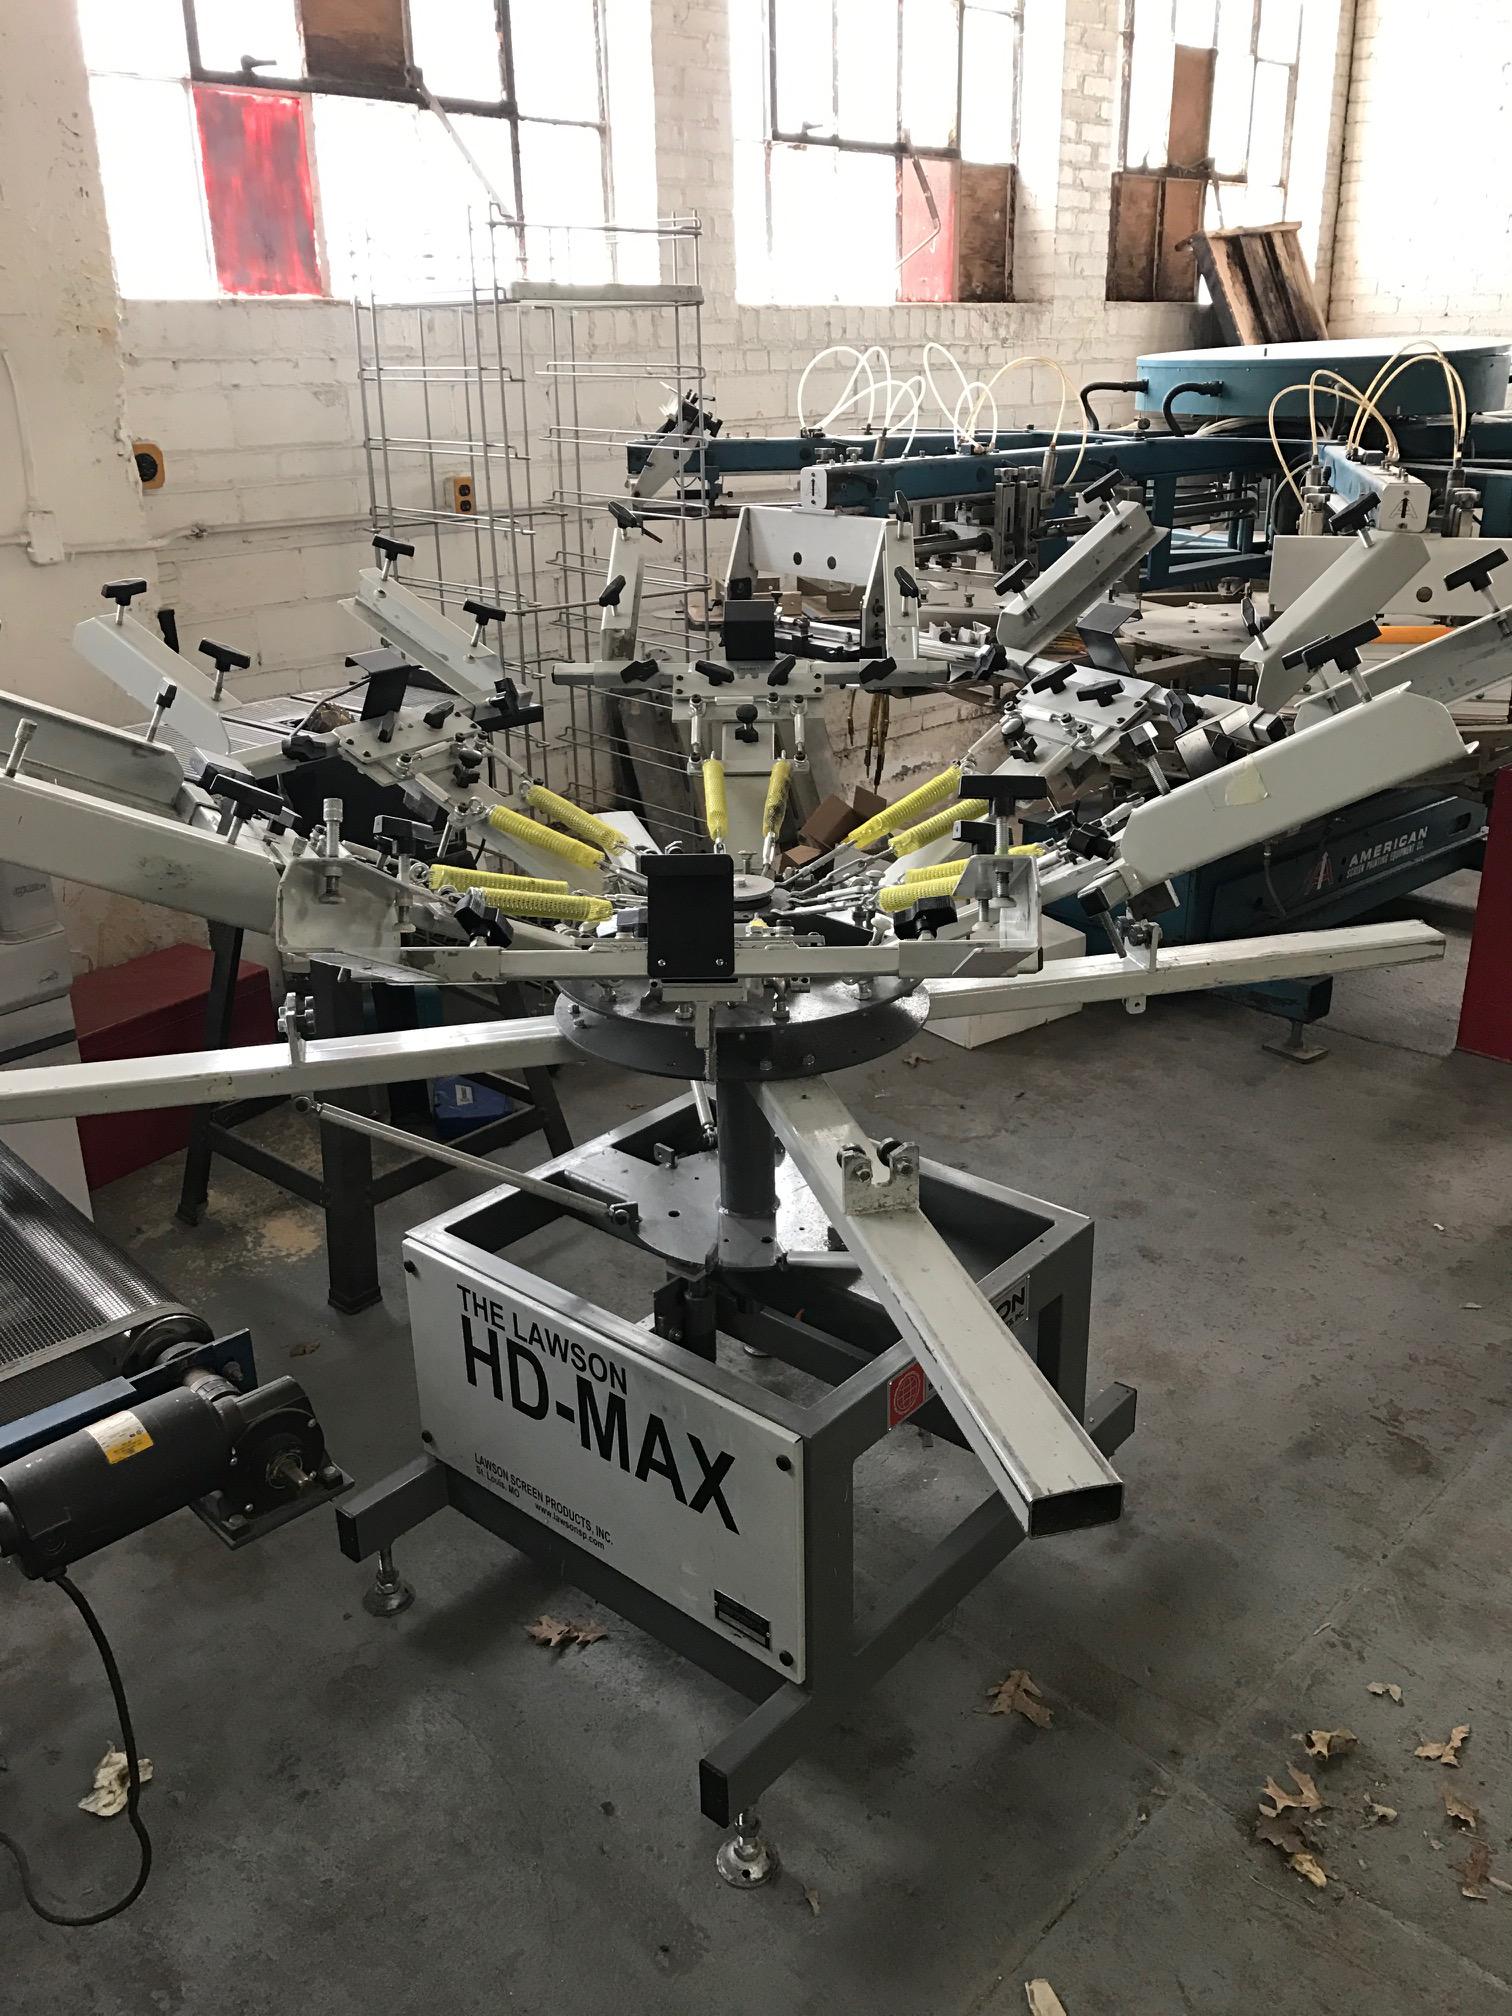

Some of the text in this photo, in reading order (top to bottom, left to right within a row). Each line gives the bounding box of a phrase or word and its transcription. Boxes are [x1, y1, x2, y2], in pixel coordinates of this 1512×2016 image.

[1349, 825, 1428, 868] AMERICAN
[996, 1286, 1026, 1320] ON
[456, 1283, 628, 1395] THE LAWSON
[459, 1314, 740, 1536] HD-MAX
[474, 1452, 614, 1545] LAWSON SCREEN PRODUCTS, INC.
[508, 1484, 520, 1498] MO
[534, 1502, 605, 1550] www.lawsonsp.com
